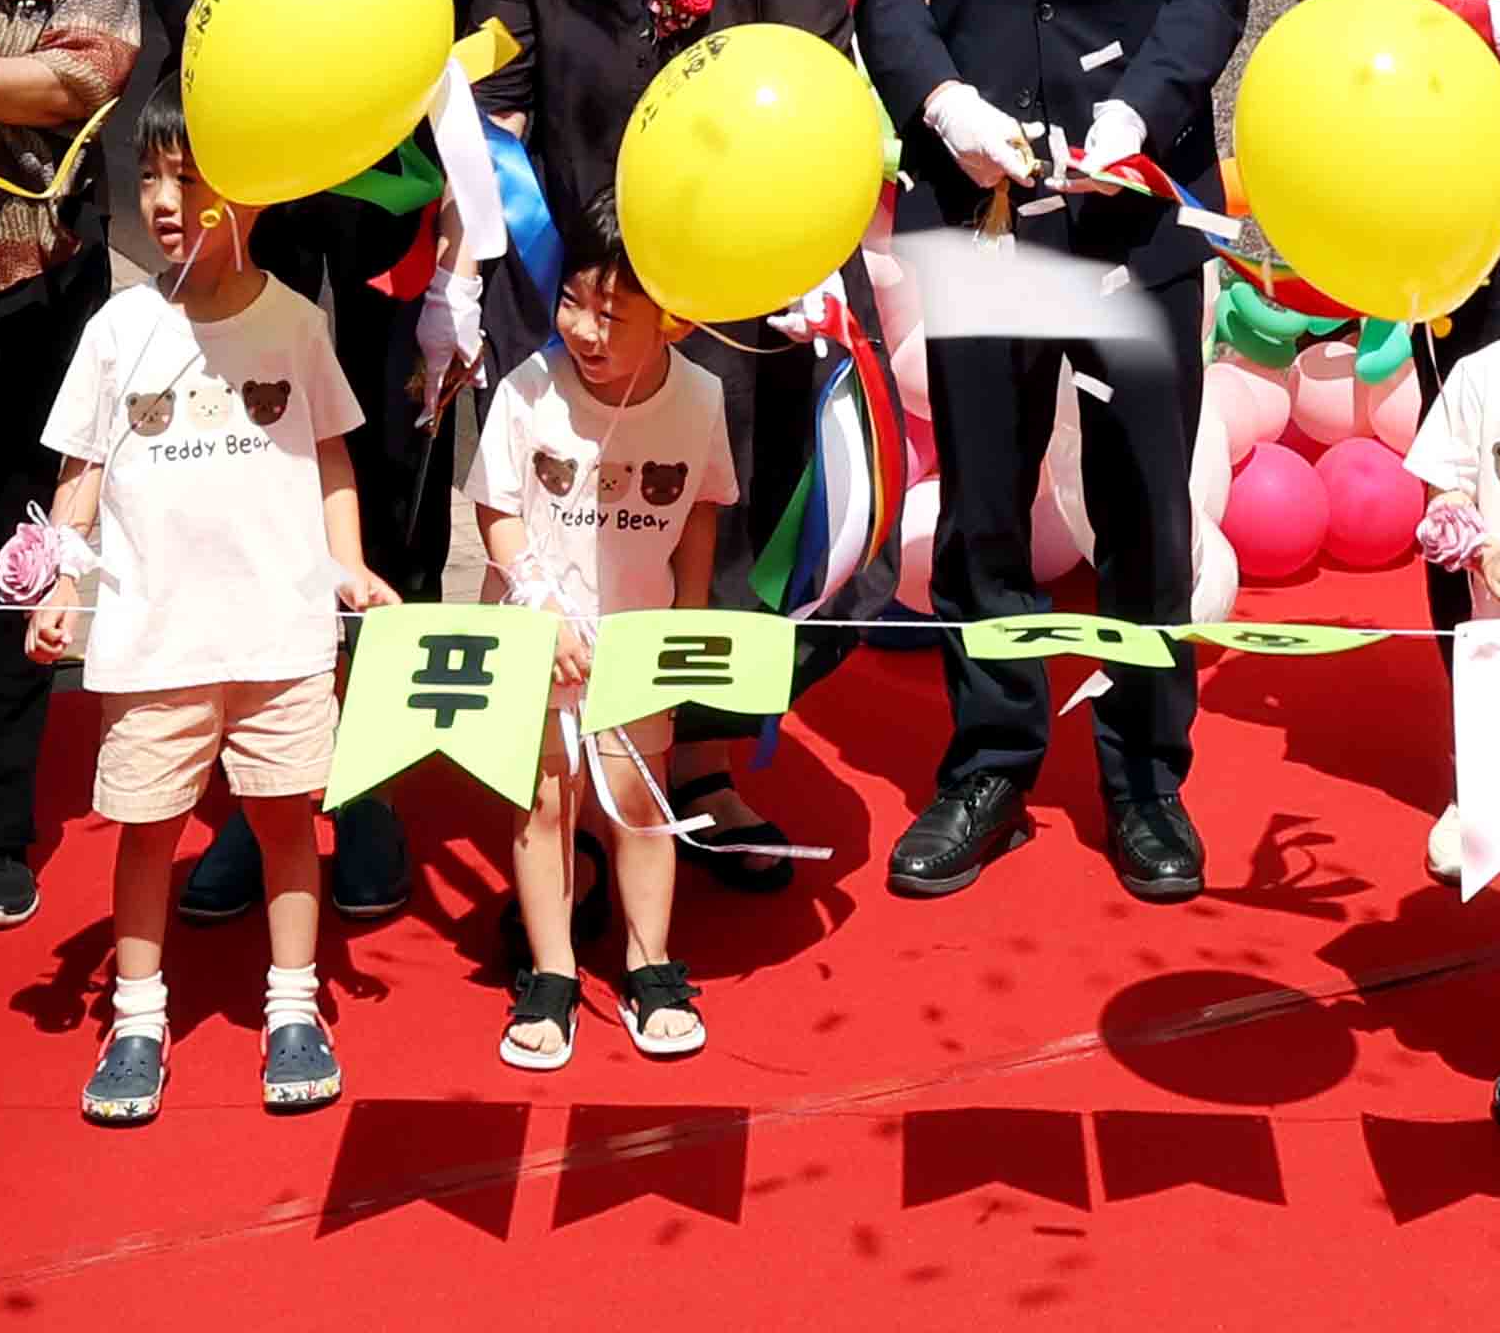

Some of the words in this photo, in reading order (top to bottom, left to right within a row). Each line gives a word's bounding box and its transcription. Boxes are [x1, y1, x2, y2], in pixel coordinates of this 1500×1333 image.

[149, 438, 216, 464] Teddy
[225, 434, 272, 456] Bear
[549, 502, 609, 528] Teddy
[616, 509, 669, 532] Bear
